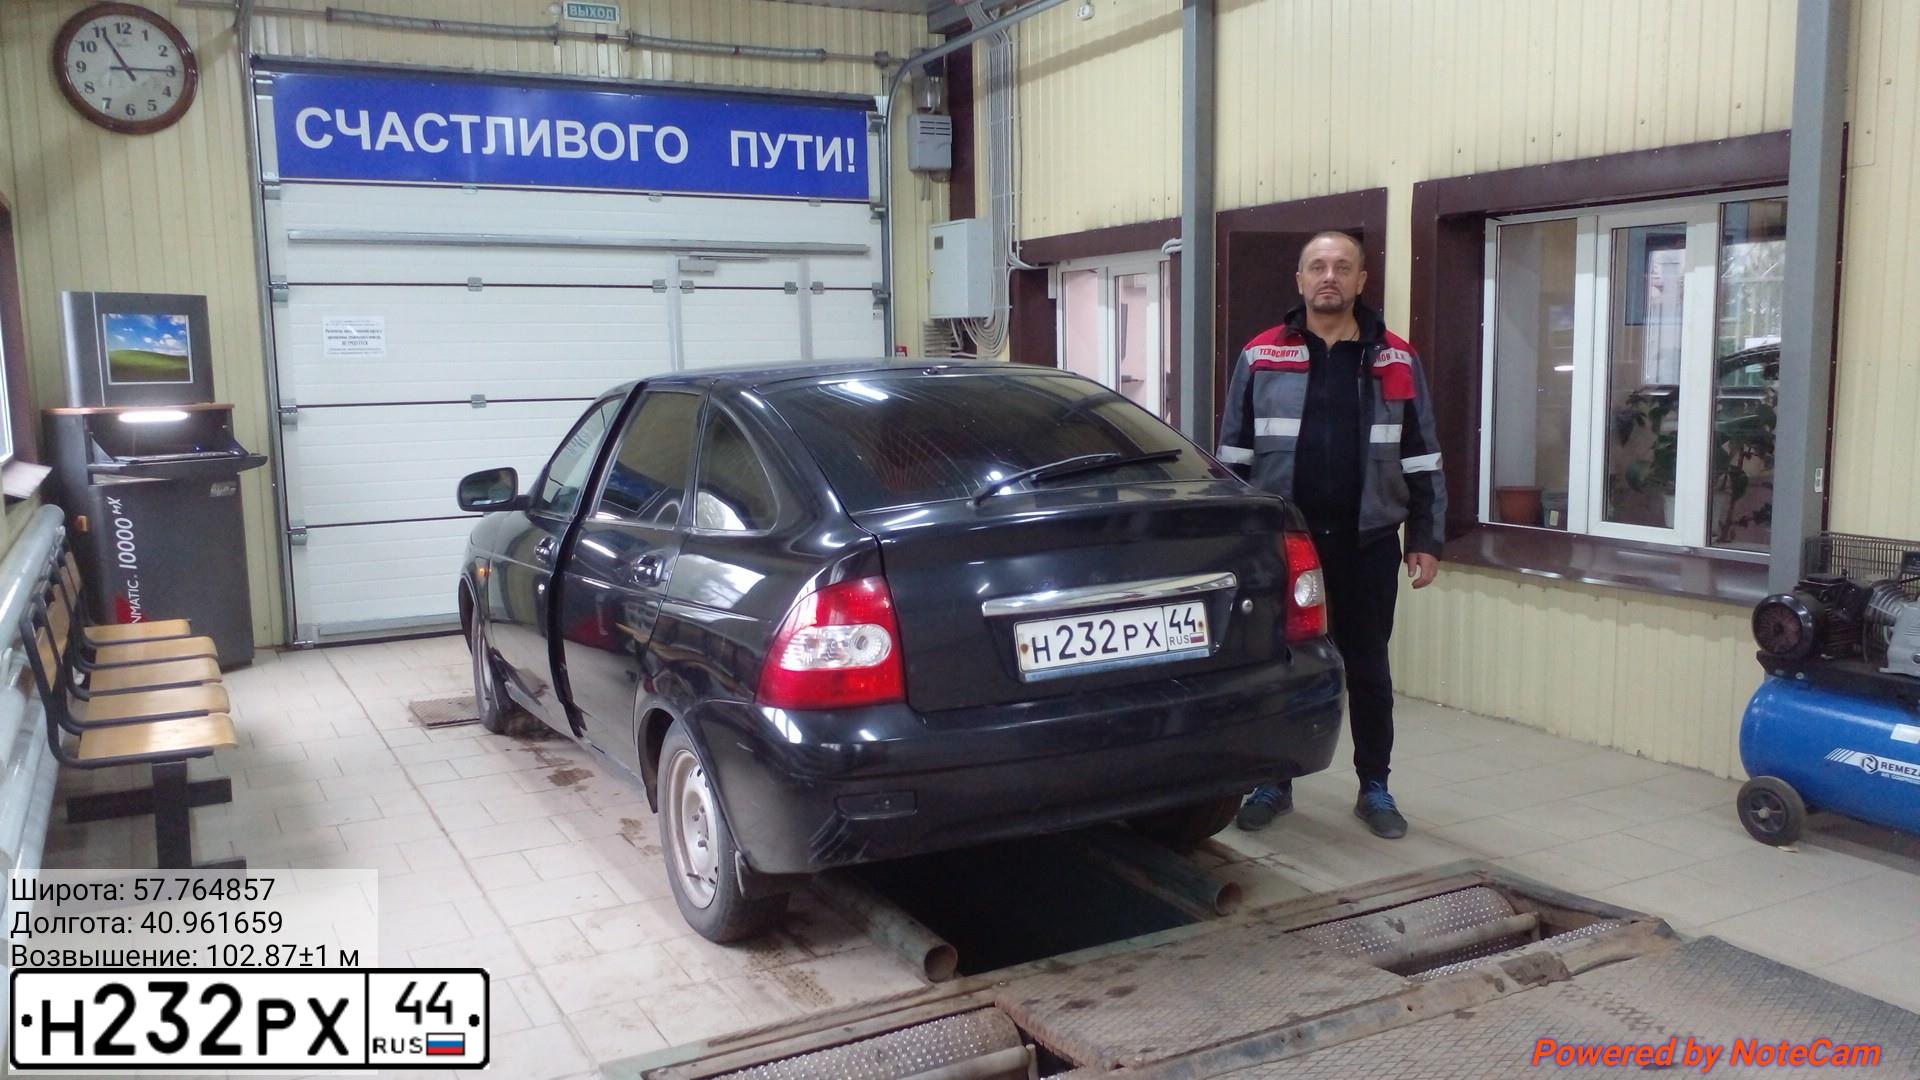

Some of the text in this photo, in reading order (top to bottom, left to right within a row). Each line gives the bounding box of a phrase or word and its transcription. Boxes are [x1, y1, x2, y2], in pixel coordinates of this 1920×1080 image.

[569, 5, 614, 20] ВЫХОД
[92, 26, 107, 38] 11
[114, 22, 132, 35] 12
[142, 29, 149, 41] 1
[80, 41, 97, 53] 10
[158, 45, 168, 57] 2
[76, 61, 87, 73] 9
[166, 65, 176, 77] 3
[84, 81, 95, 94] 8
[162, 86, 171, 97] 4
[102, 97, 112, 110] 7
[125, 103, 136, 116] 6
[147, 99, 157, 111] 5
[295, 106, 857, 173] СЧАСТЛИВОГО ПУТИ!
[114, 517, 137, 569] 10000
[1031, 607, 1197, 663] Н232РХ 44
[1169, 635, 1190, 646] RUS
[1880, 761, 1920, 777] REMEZ
